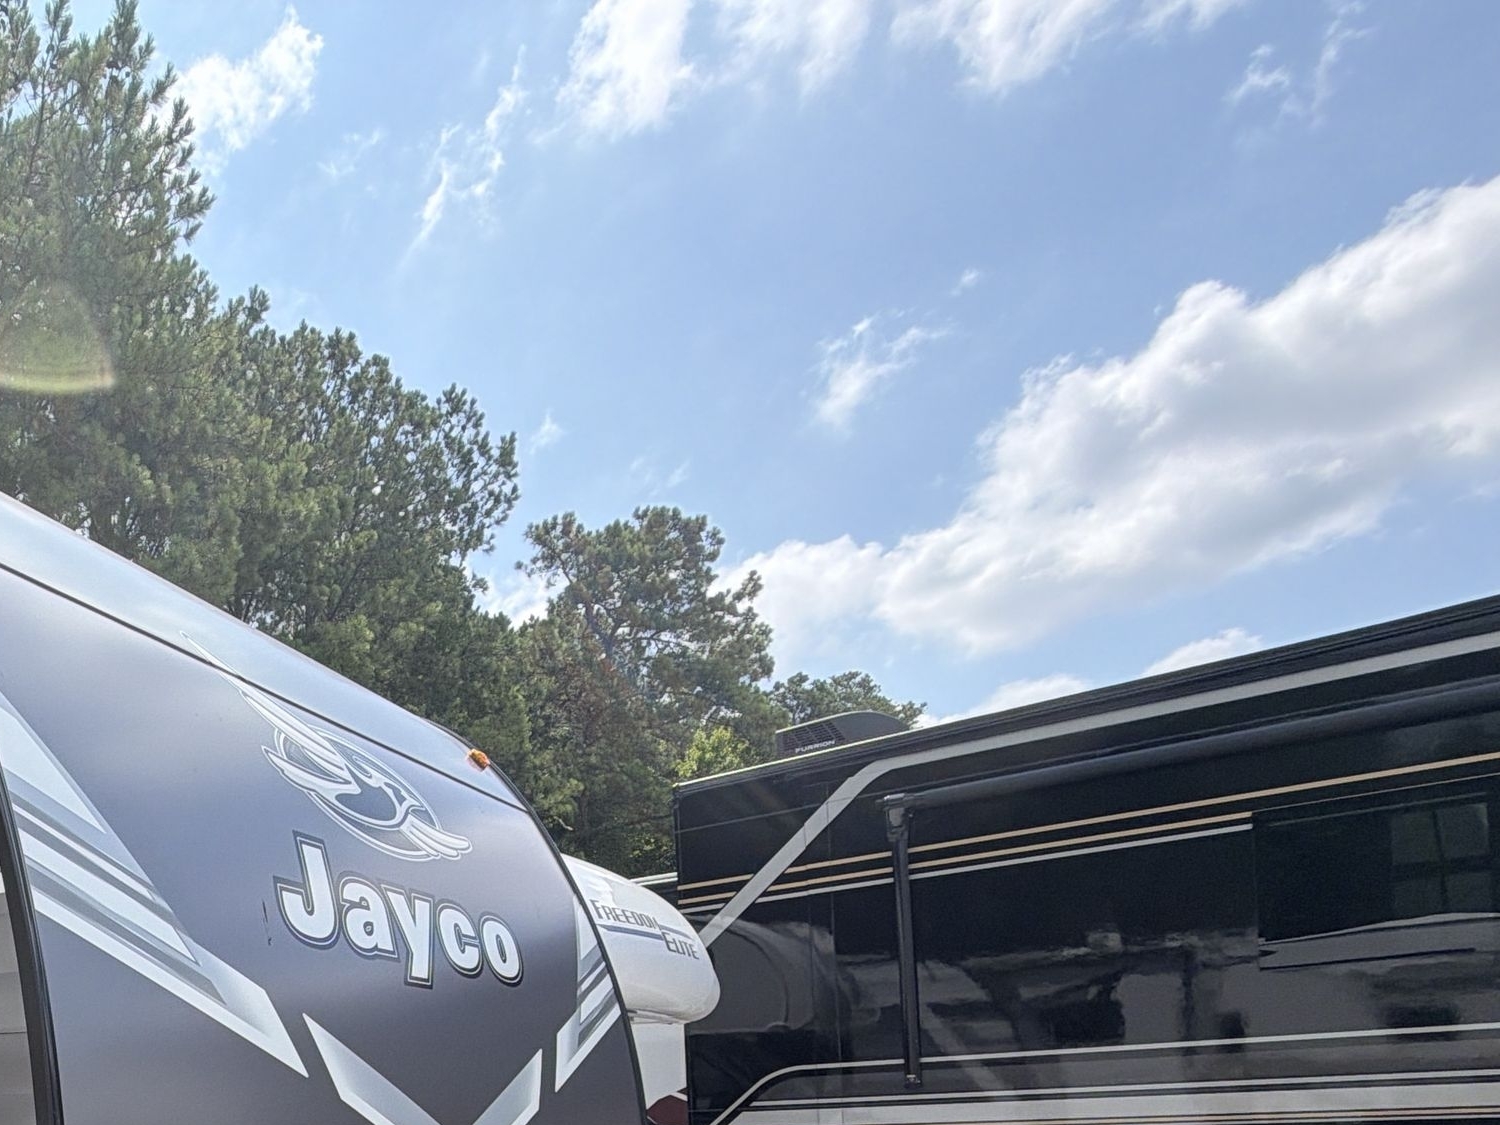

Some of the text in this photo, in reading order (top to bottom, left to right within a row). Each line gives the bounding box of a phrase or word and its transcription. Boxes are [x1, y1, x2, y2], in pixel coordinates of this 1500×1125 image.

[795, 740, 836, 753] FURRION
[274, 832, 523, 988] Jayco
[589, 899, 660, 930] FREEDOM
[661, 931, 700, 960] ELITE
